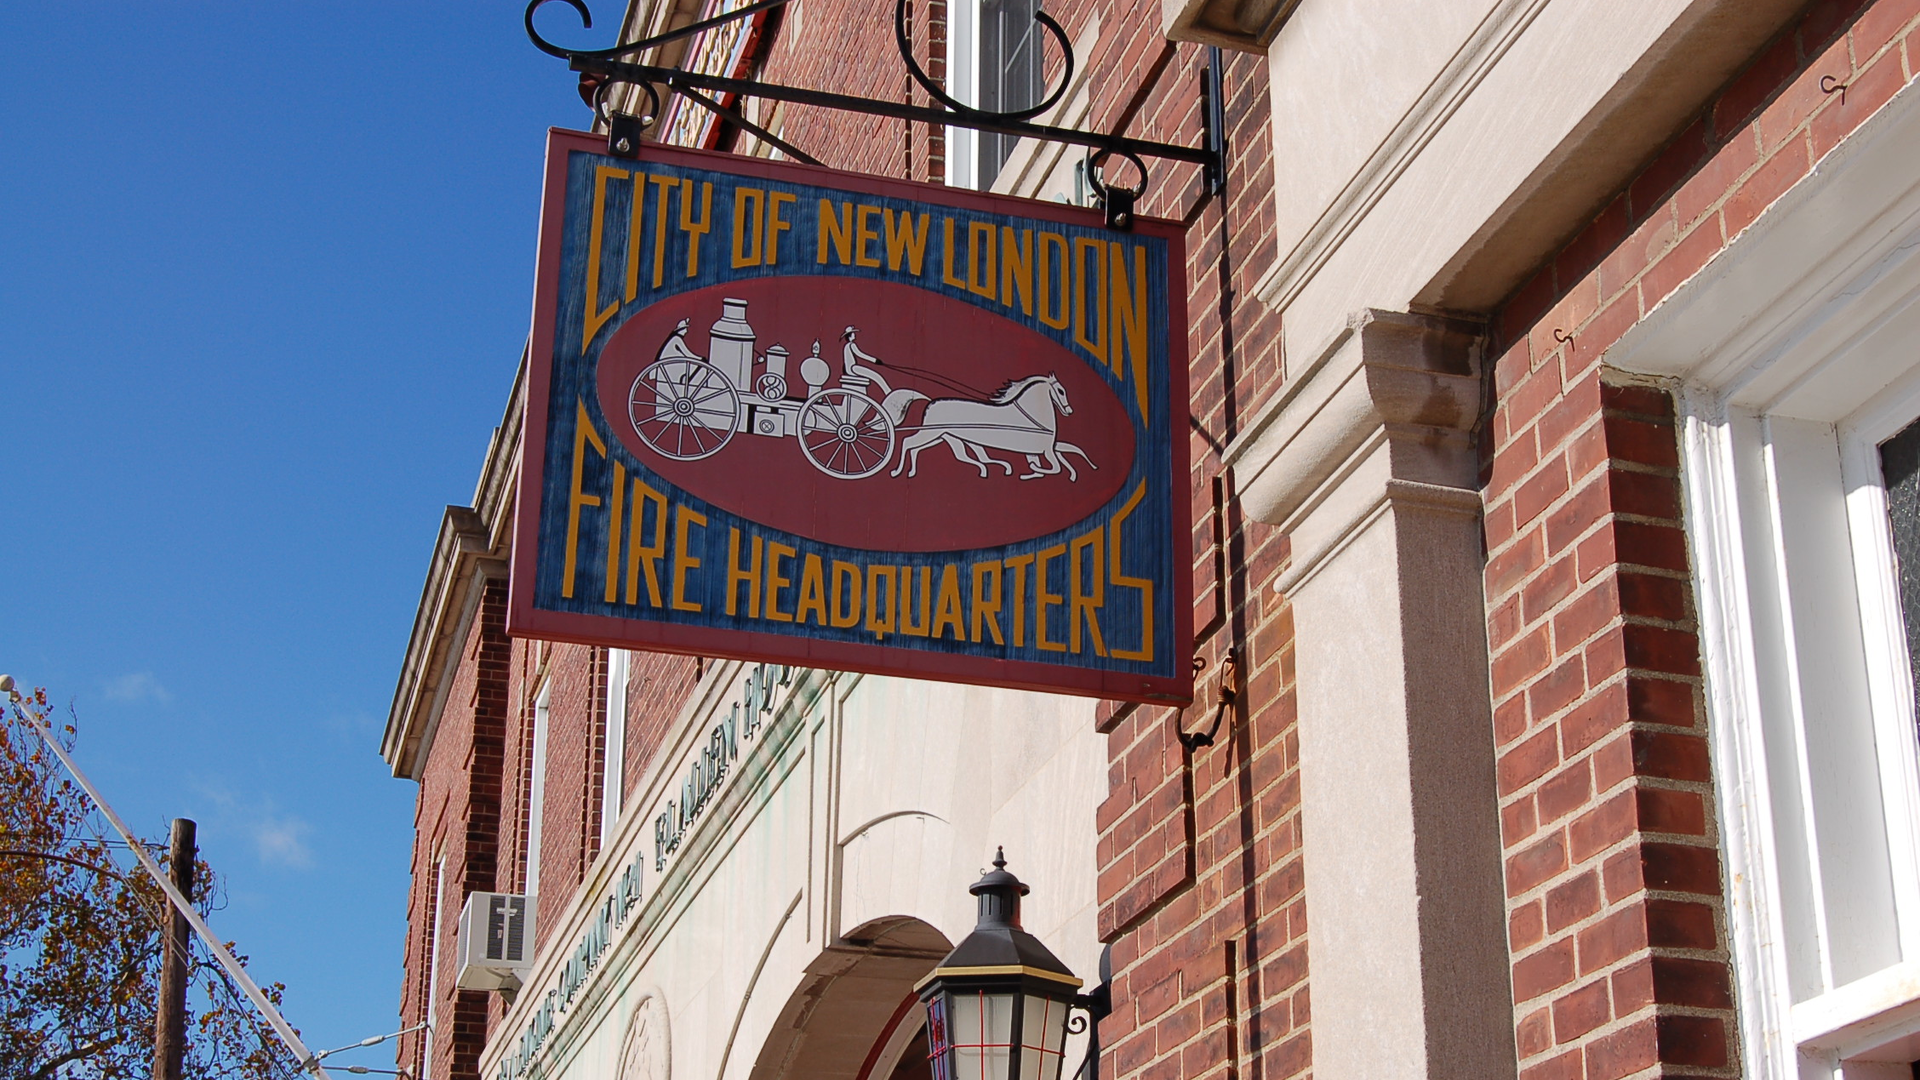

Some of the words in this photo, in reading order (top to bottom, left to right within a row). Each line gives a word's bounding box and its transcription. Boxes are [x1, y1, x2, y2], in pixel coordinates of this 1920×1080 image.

[583, 165, 713, 354] CITY
[732, 187, 797, 269] OF
[817, 198, 930, 276] NEW
[943, 217, 1148, 428] LONDON
[562, 395, 707, 612] FIRE
[726, 478, 1154, 662] HEADQUARTERS
[678, 702, 739, 834] ALLEN
